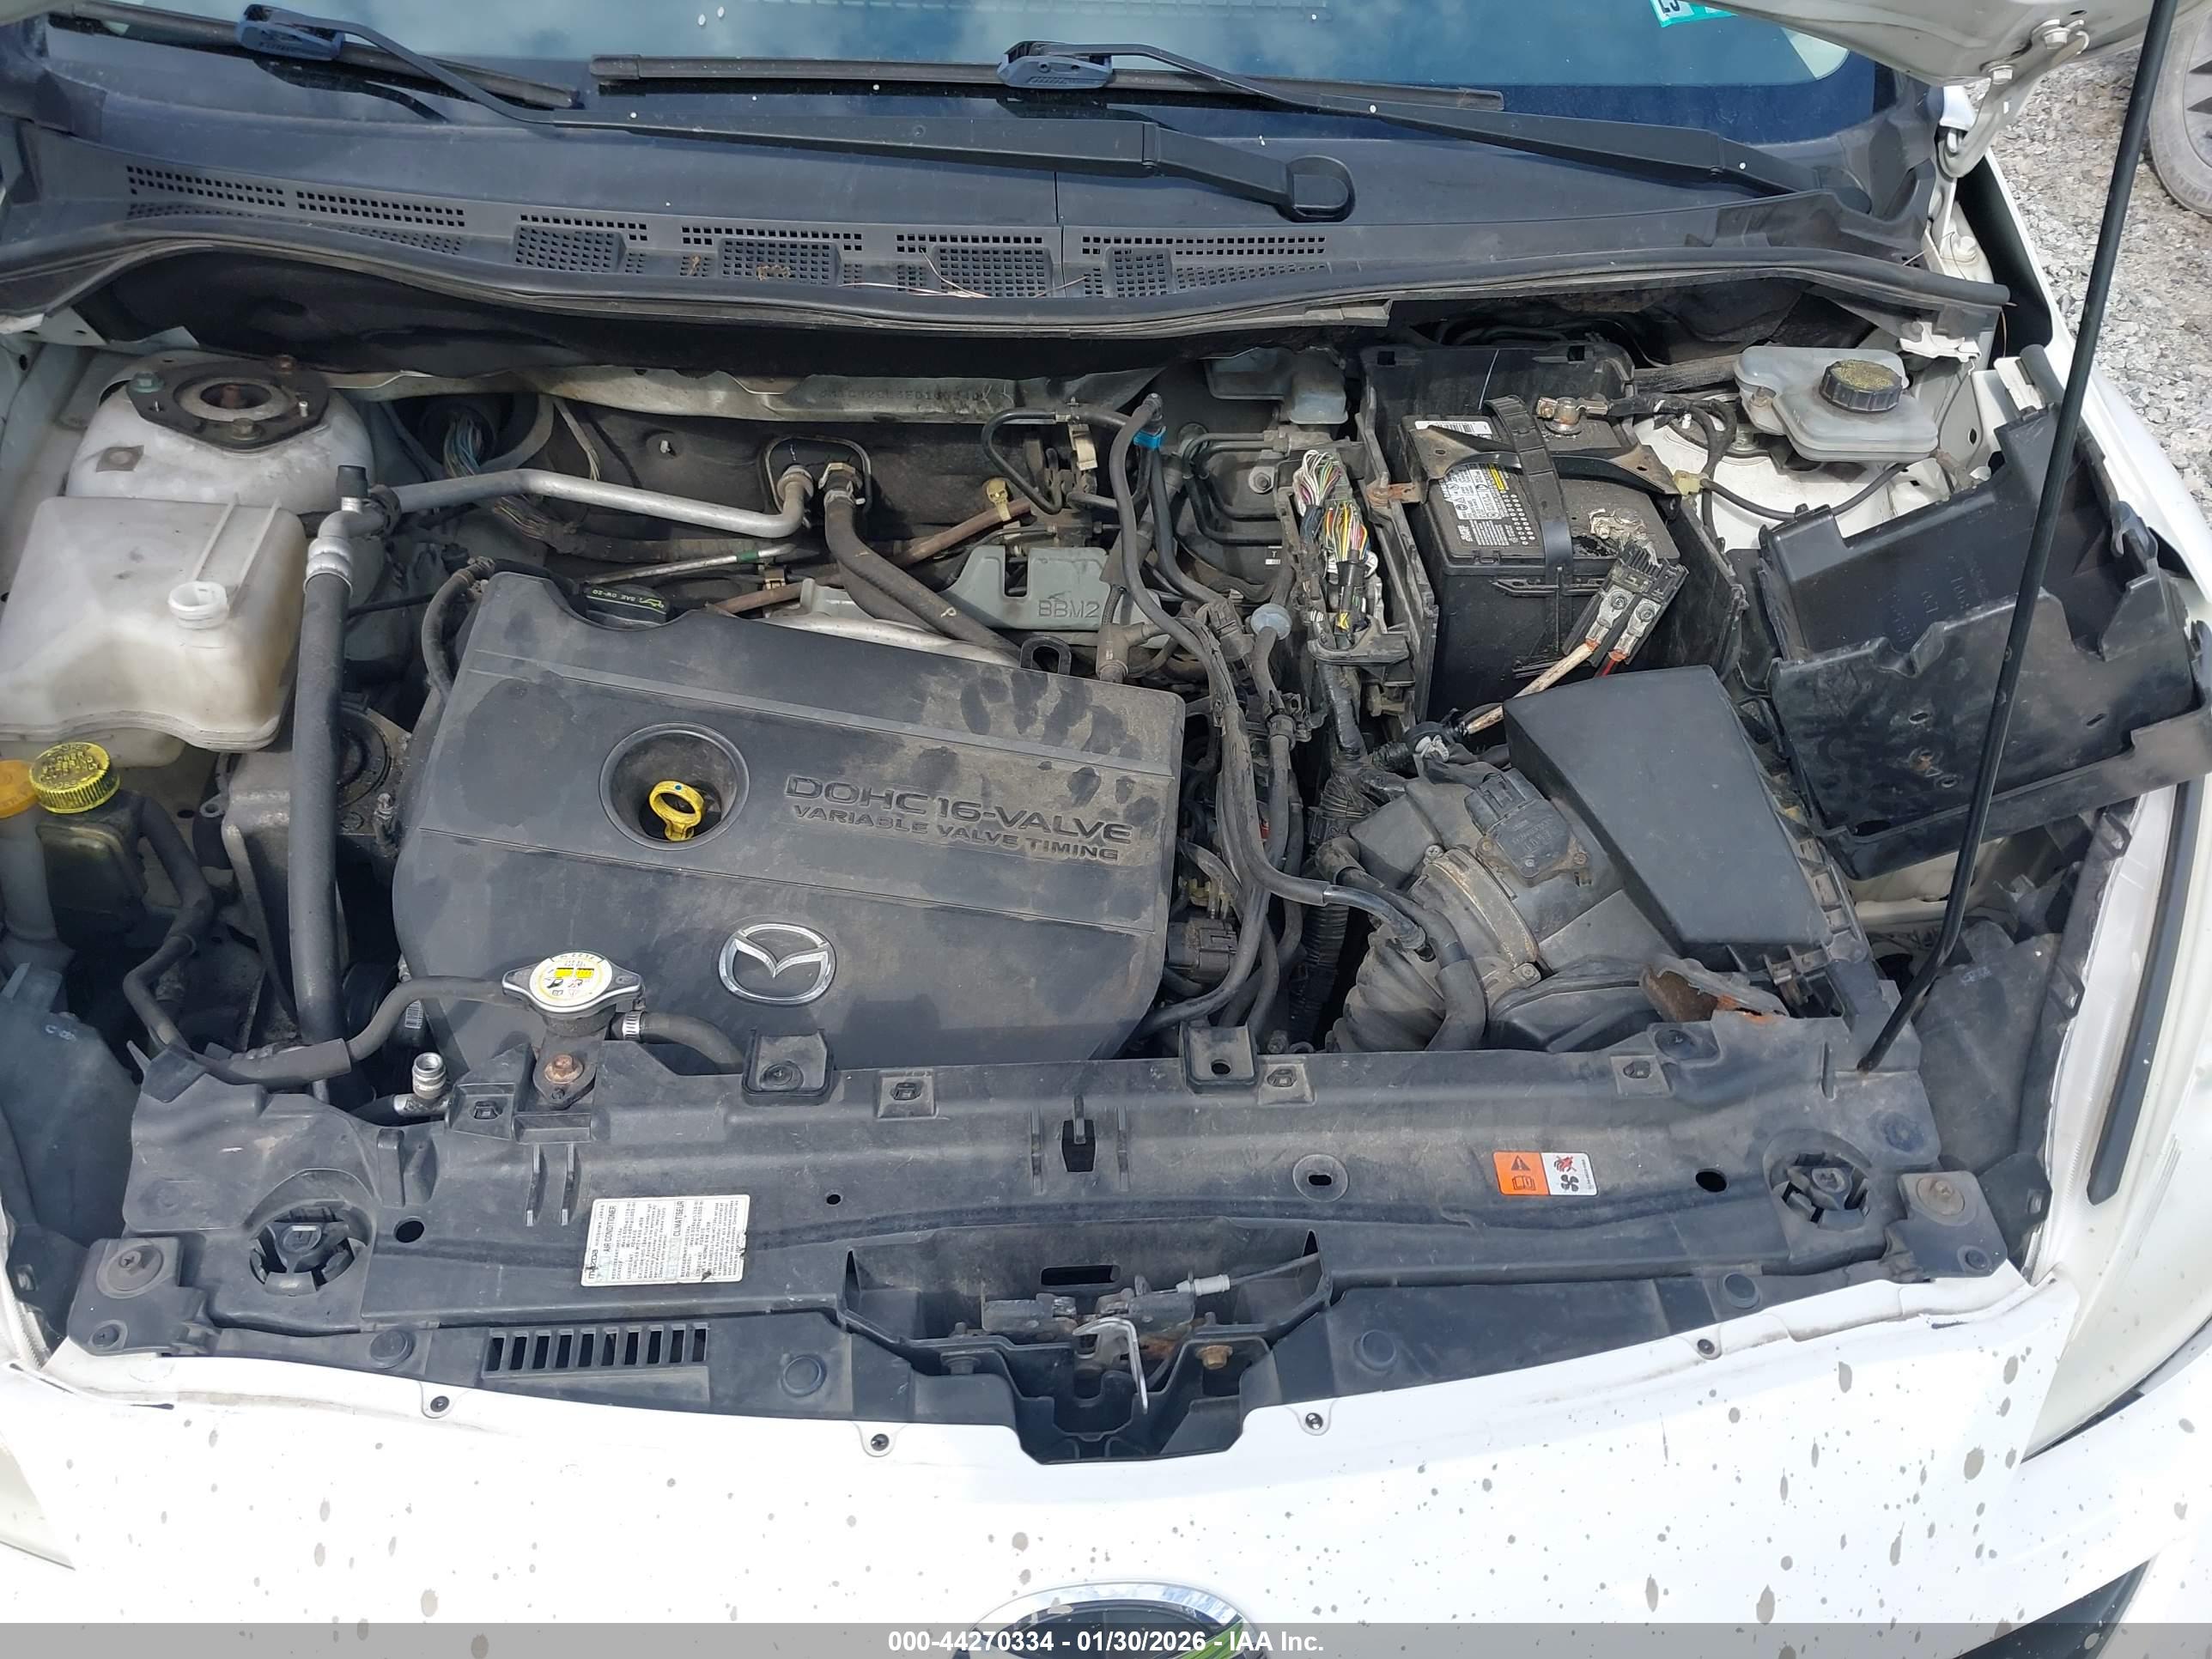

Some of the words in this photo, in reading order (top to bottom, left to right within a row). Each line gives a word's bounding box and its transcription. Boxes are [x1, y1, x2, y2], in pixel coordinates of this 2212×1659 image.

[1038, 599, 1101, 619] BBM2
[784, 775, 928, 815] DOHC
[938, 797, 1134, 845] 16-VALVE
[793, 804, 930, 836] VARIABLE
[937, 823, 1019, 847] VALVE
[1026, 836, 1119, 860] TIMING
[604, 1206, 616, 1242] CONDITIONER
[672, 1200, 684, 1236] CLIMATISEUR
